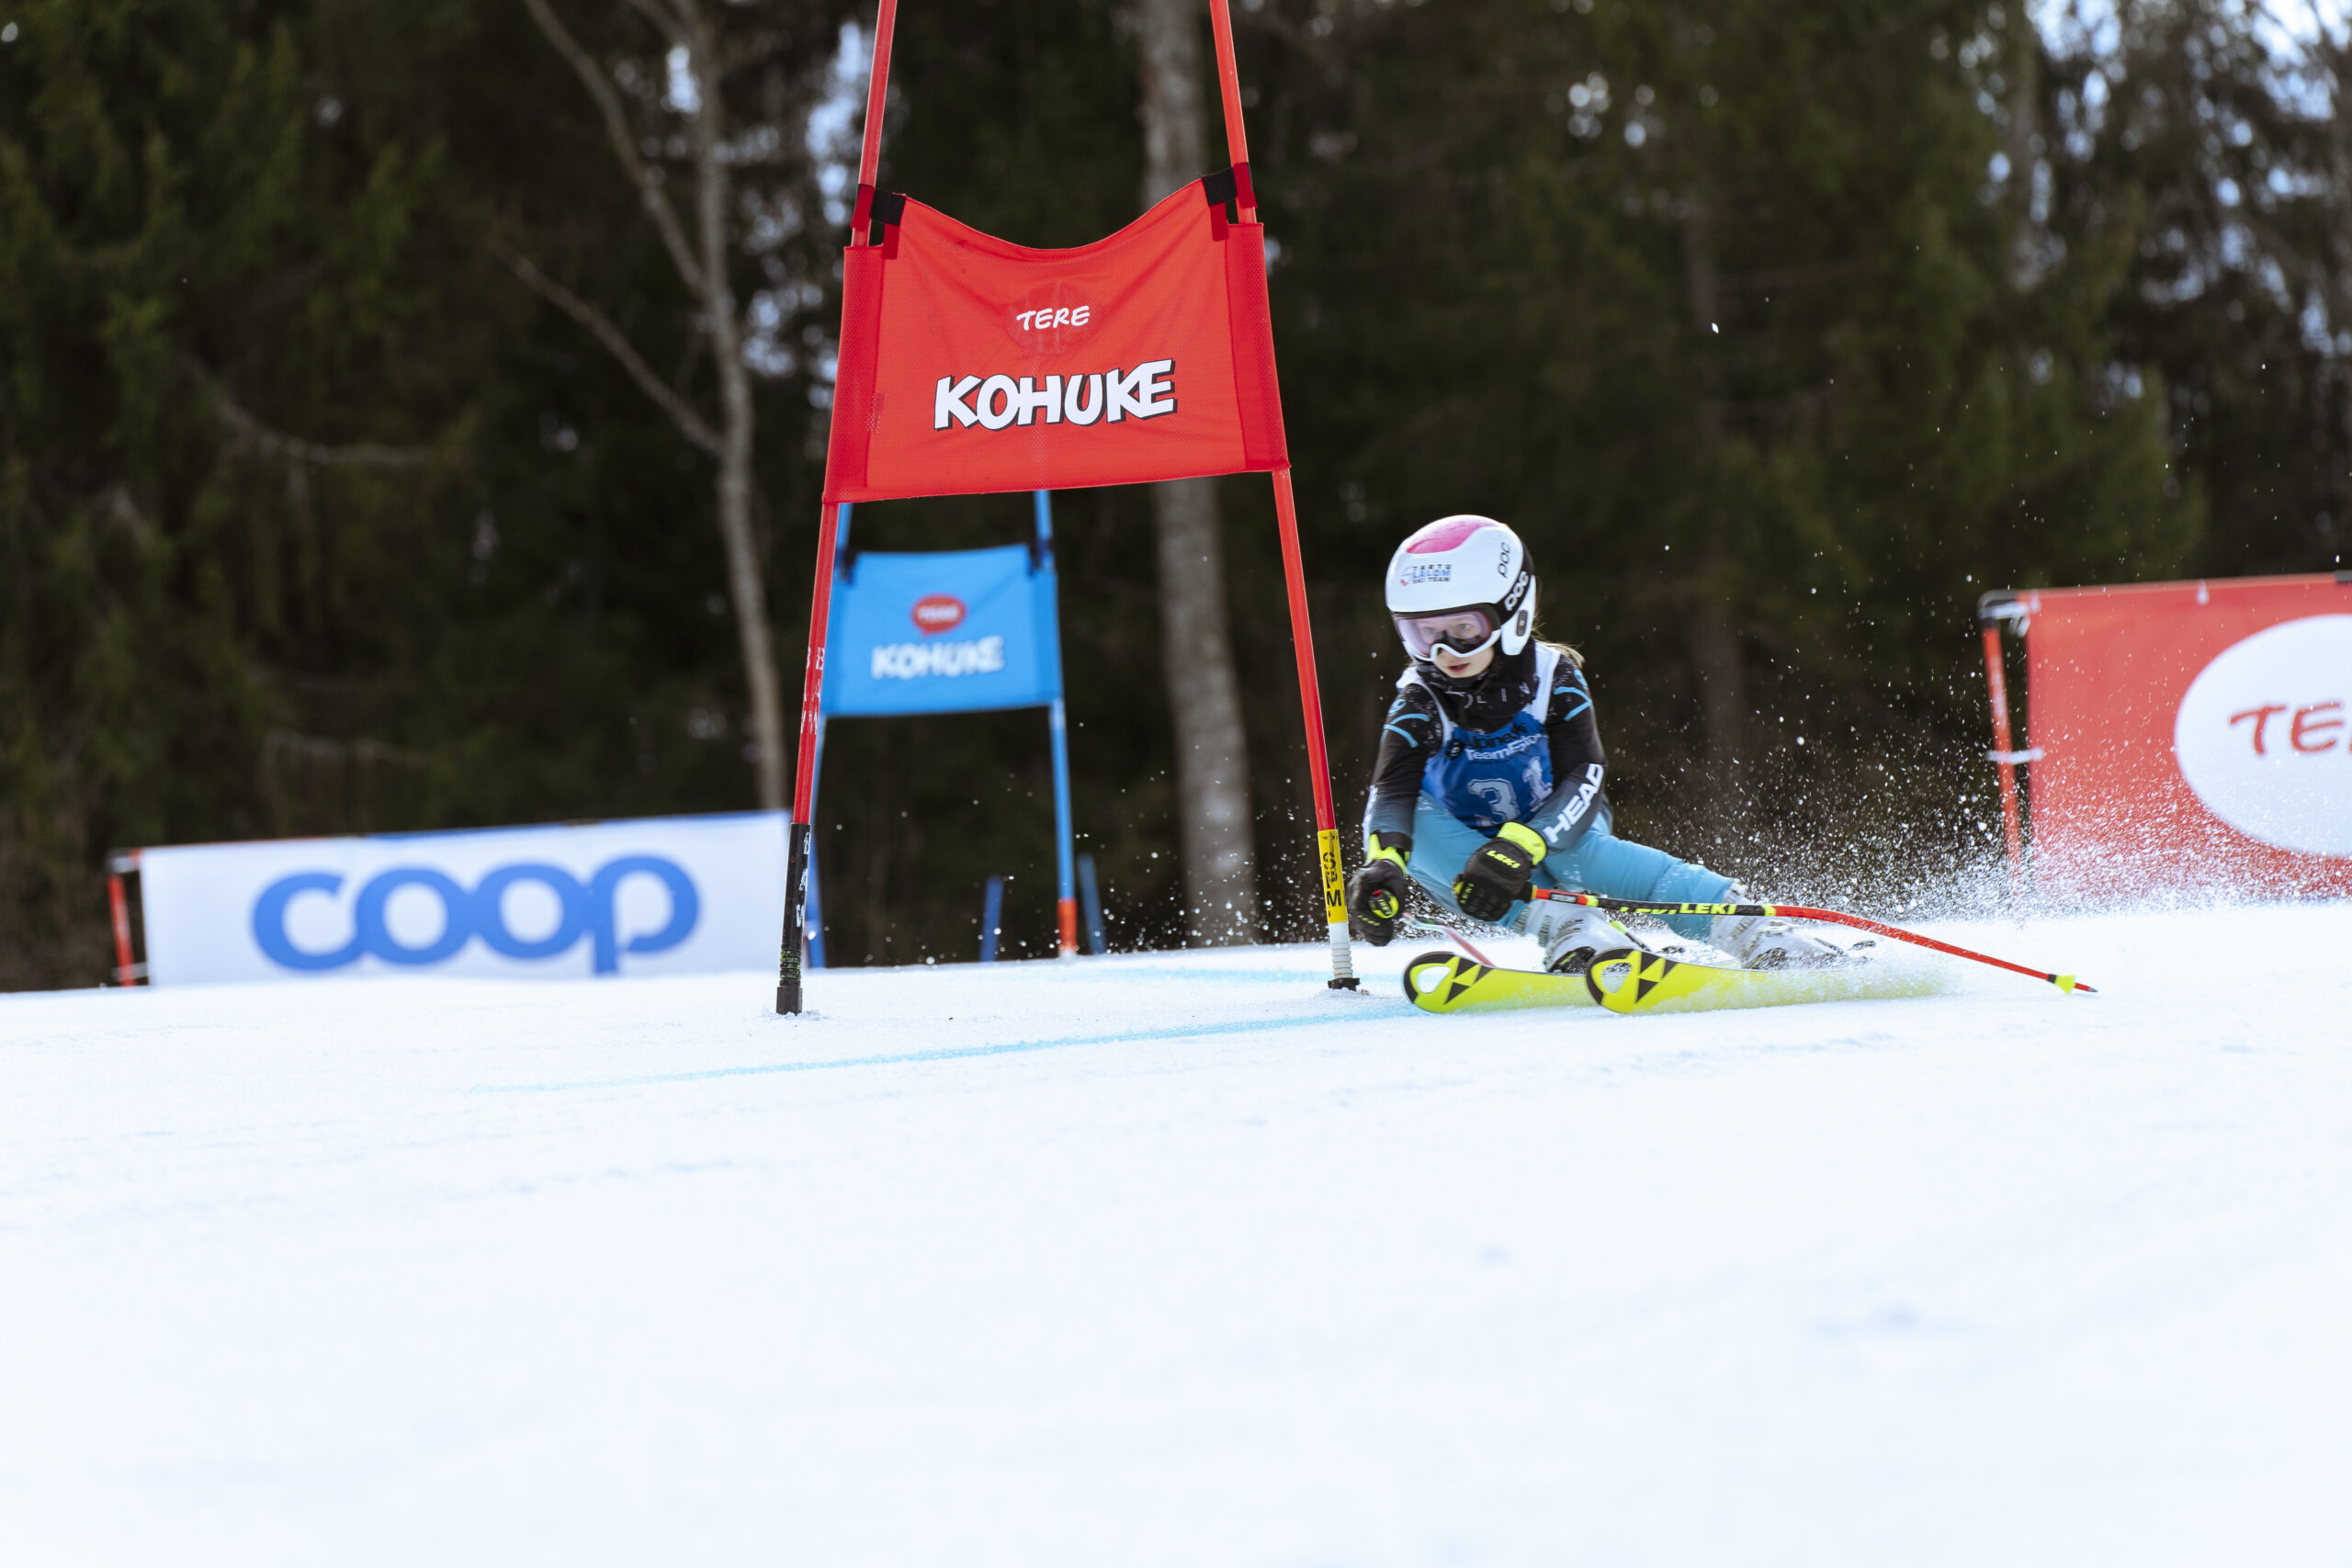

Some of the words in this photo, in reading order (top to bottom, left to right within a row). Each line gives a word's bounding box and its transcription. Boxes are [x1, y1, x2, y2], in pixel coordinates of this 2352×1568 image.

[1016, 305, 1091, 332] TERE
[933, 358, 1178, 431] KOHUKE
[870, 636, 1005, 680] KOHUKE
[2228, 700, 2352, 757] TE
[1467, 756, 1553, 825] 31
[1543, 763, 1604, 842] HEAD
[1486, 850, 1521, 869] LEKI
[253, 854, 701, 976] coop
[1679, 903, 1737, 915] LEKI
